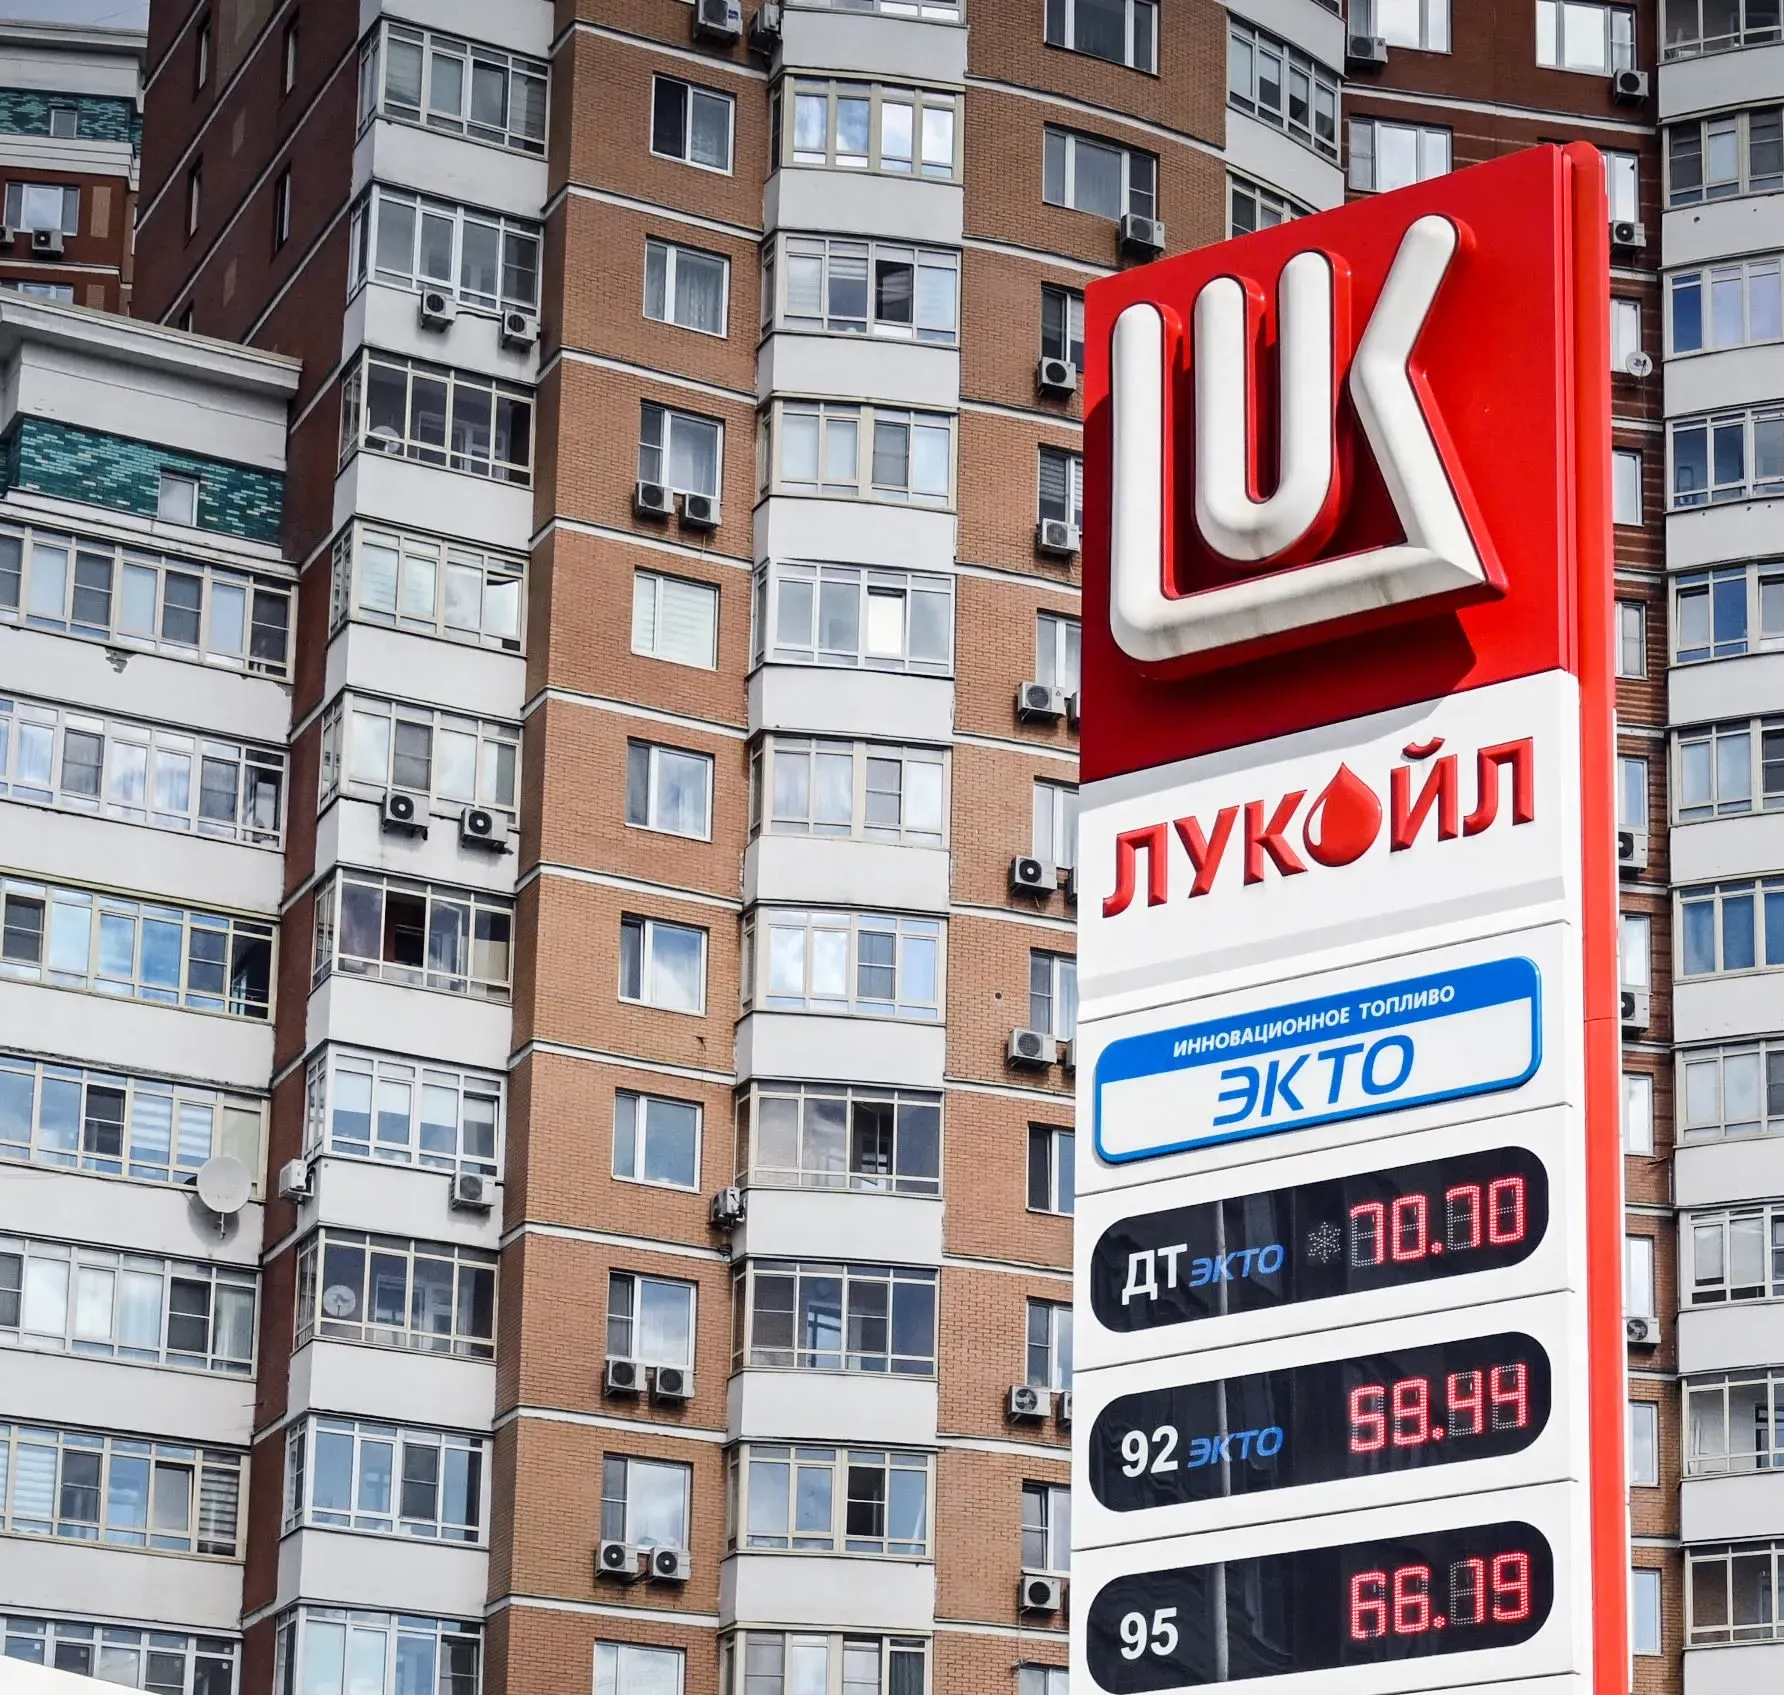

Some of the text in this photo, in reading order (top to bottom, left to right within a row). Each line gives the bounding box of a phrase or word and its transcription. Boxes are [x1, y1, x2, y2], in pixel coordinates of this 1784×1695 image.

[1102, 737, 1535, 918] ЛУКОЙЛ
[1173, 985, 1455, 1058] ИННОВАЦИОННОЕ ТОПЛИВО
[1212, 1034, 1415, 1127] ЭКТО
[1121, 1177, 1525, 1305] ДТ ЭКТО 70.70
[1121, 1363, 1526, 1478] 92 ЭКТО 59.44
[1119, 1552, 1529, 1660] 95 66.19
